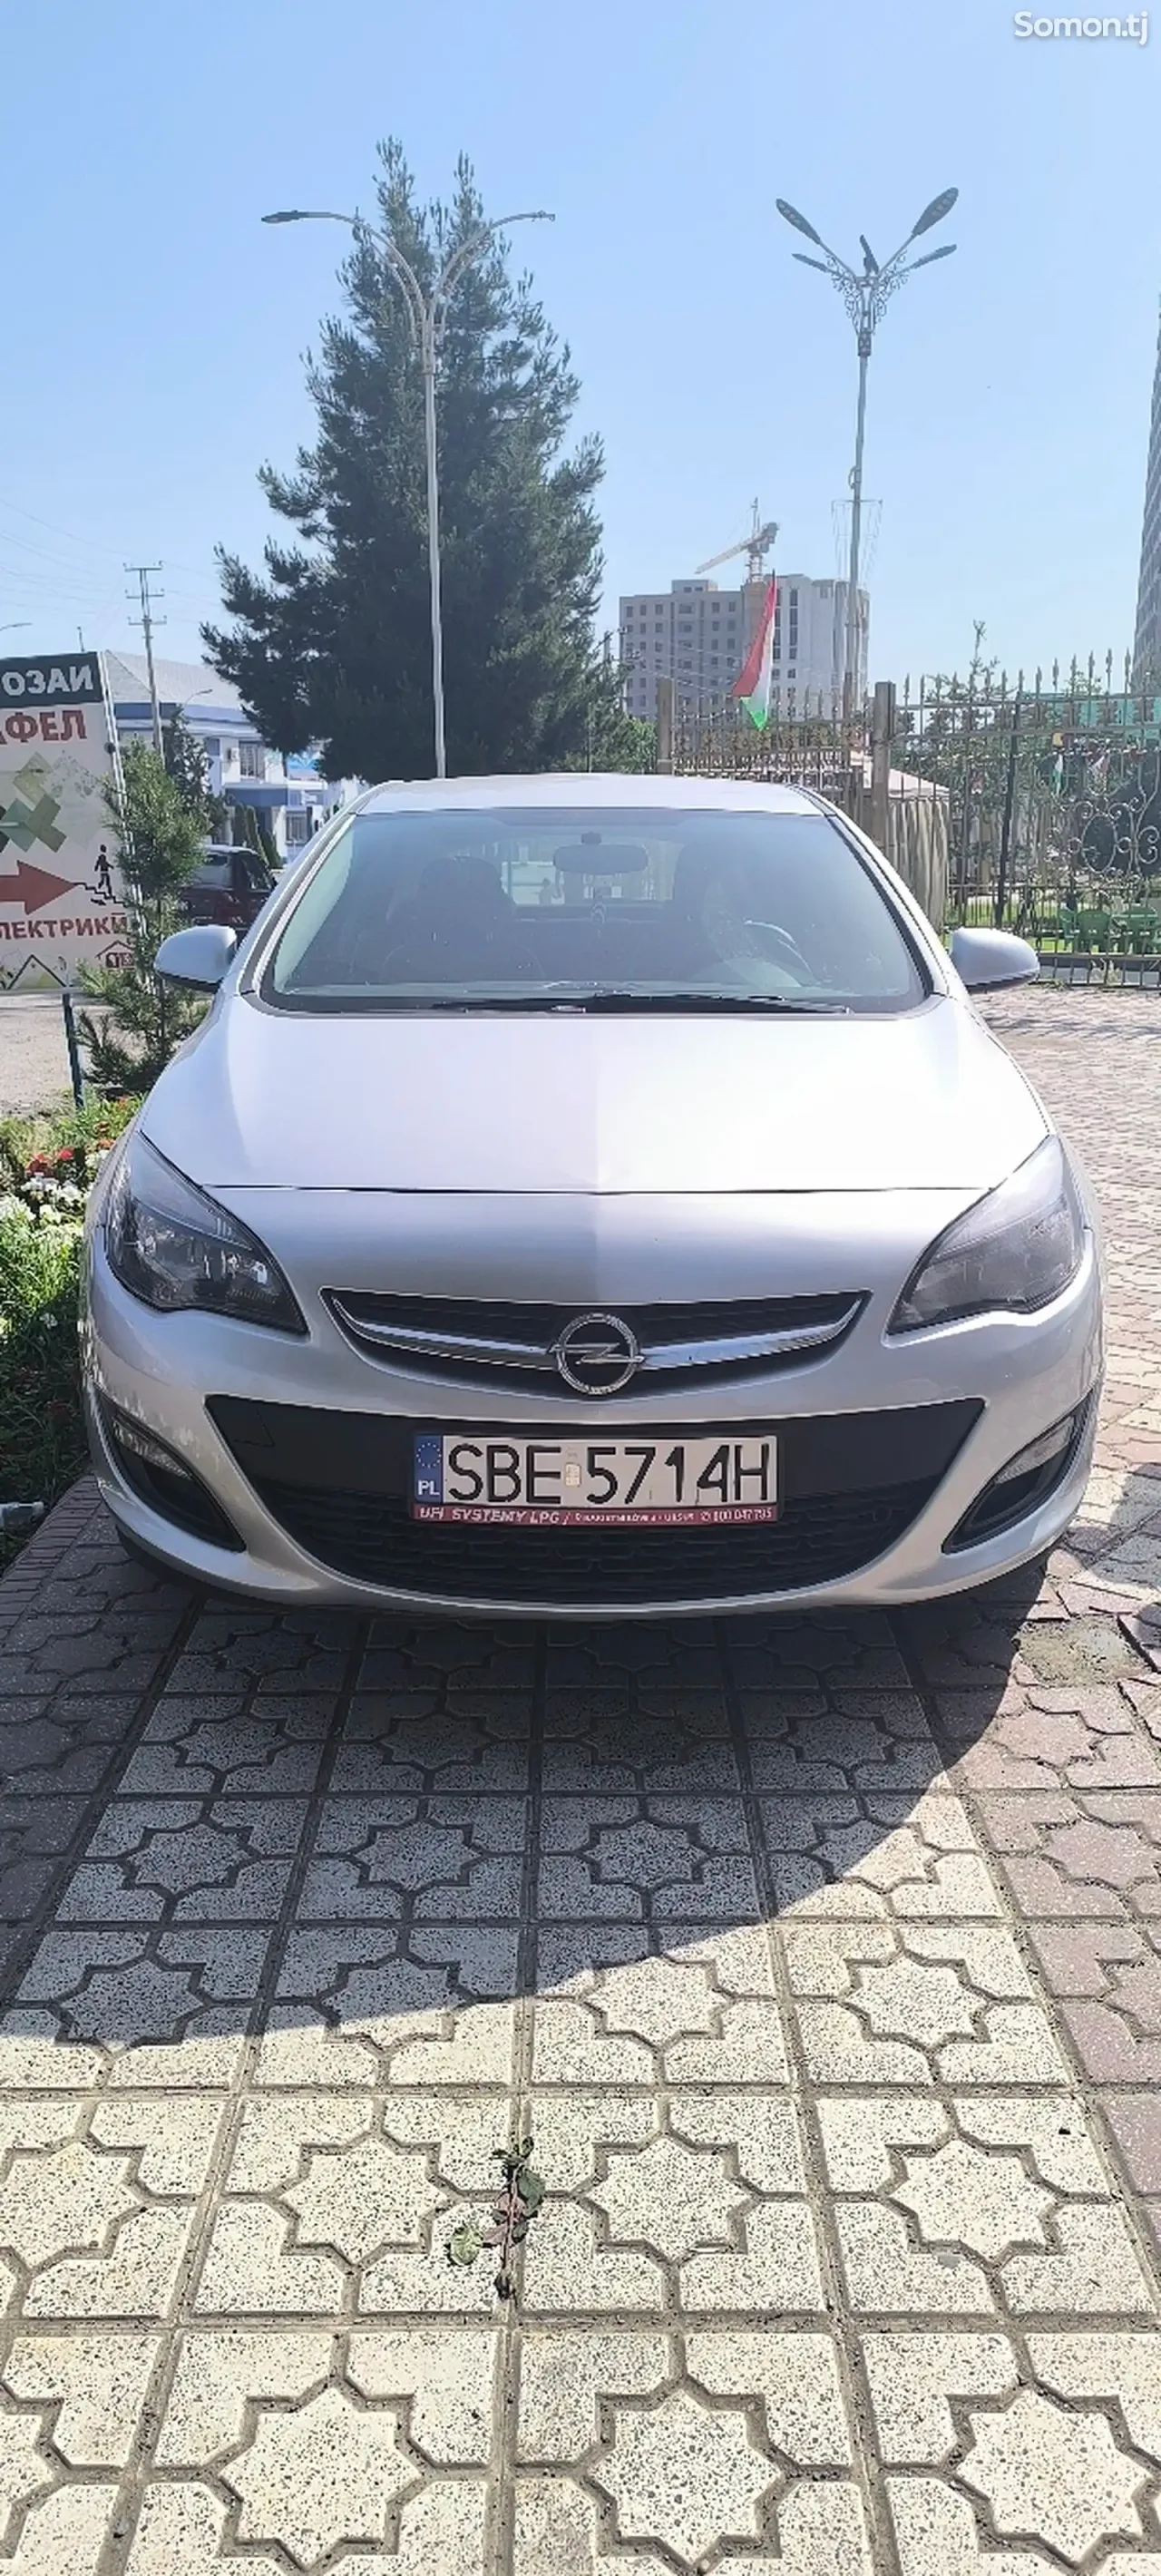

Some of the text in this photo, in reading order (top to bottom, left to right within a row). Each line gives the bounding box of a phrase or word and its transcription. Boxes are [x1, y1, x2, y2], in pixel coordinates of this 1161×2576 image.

[449, 1443, 770, 1504] SBE 5714H
[417, 1479, 440, 1496] PL
[453, 1508, 527, 1523] SYSTEMY
[530, 1511, 560, 1525] LPG
